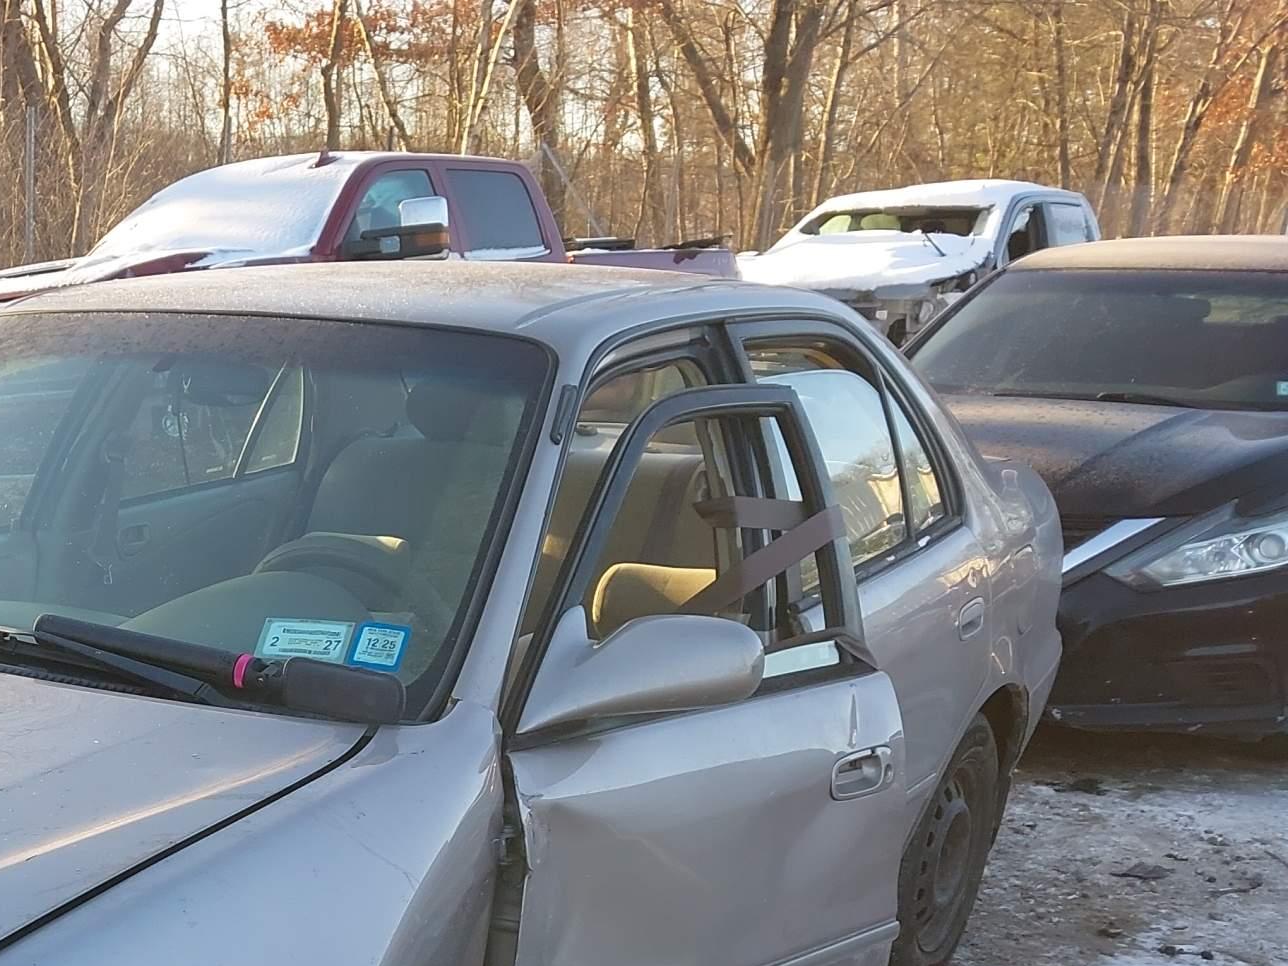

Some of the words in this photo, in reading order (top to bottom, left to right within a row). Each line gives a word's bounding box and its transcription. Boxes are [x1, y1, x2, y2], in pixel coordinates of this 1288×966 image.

[270, 636, 280, 647] 2
[323, 639, 342, 651] 27
[367, 637, 380, 648] 12
[381, 639, 397, 650] 25
